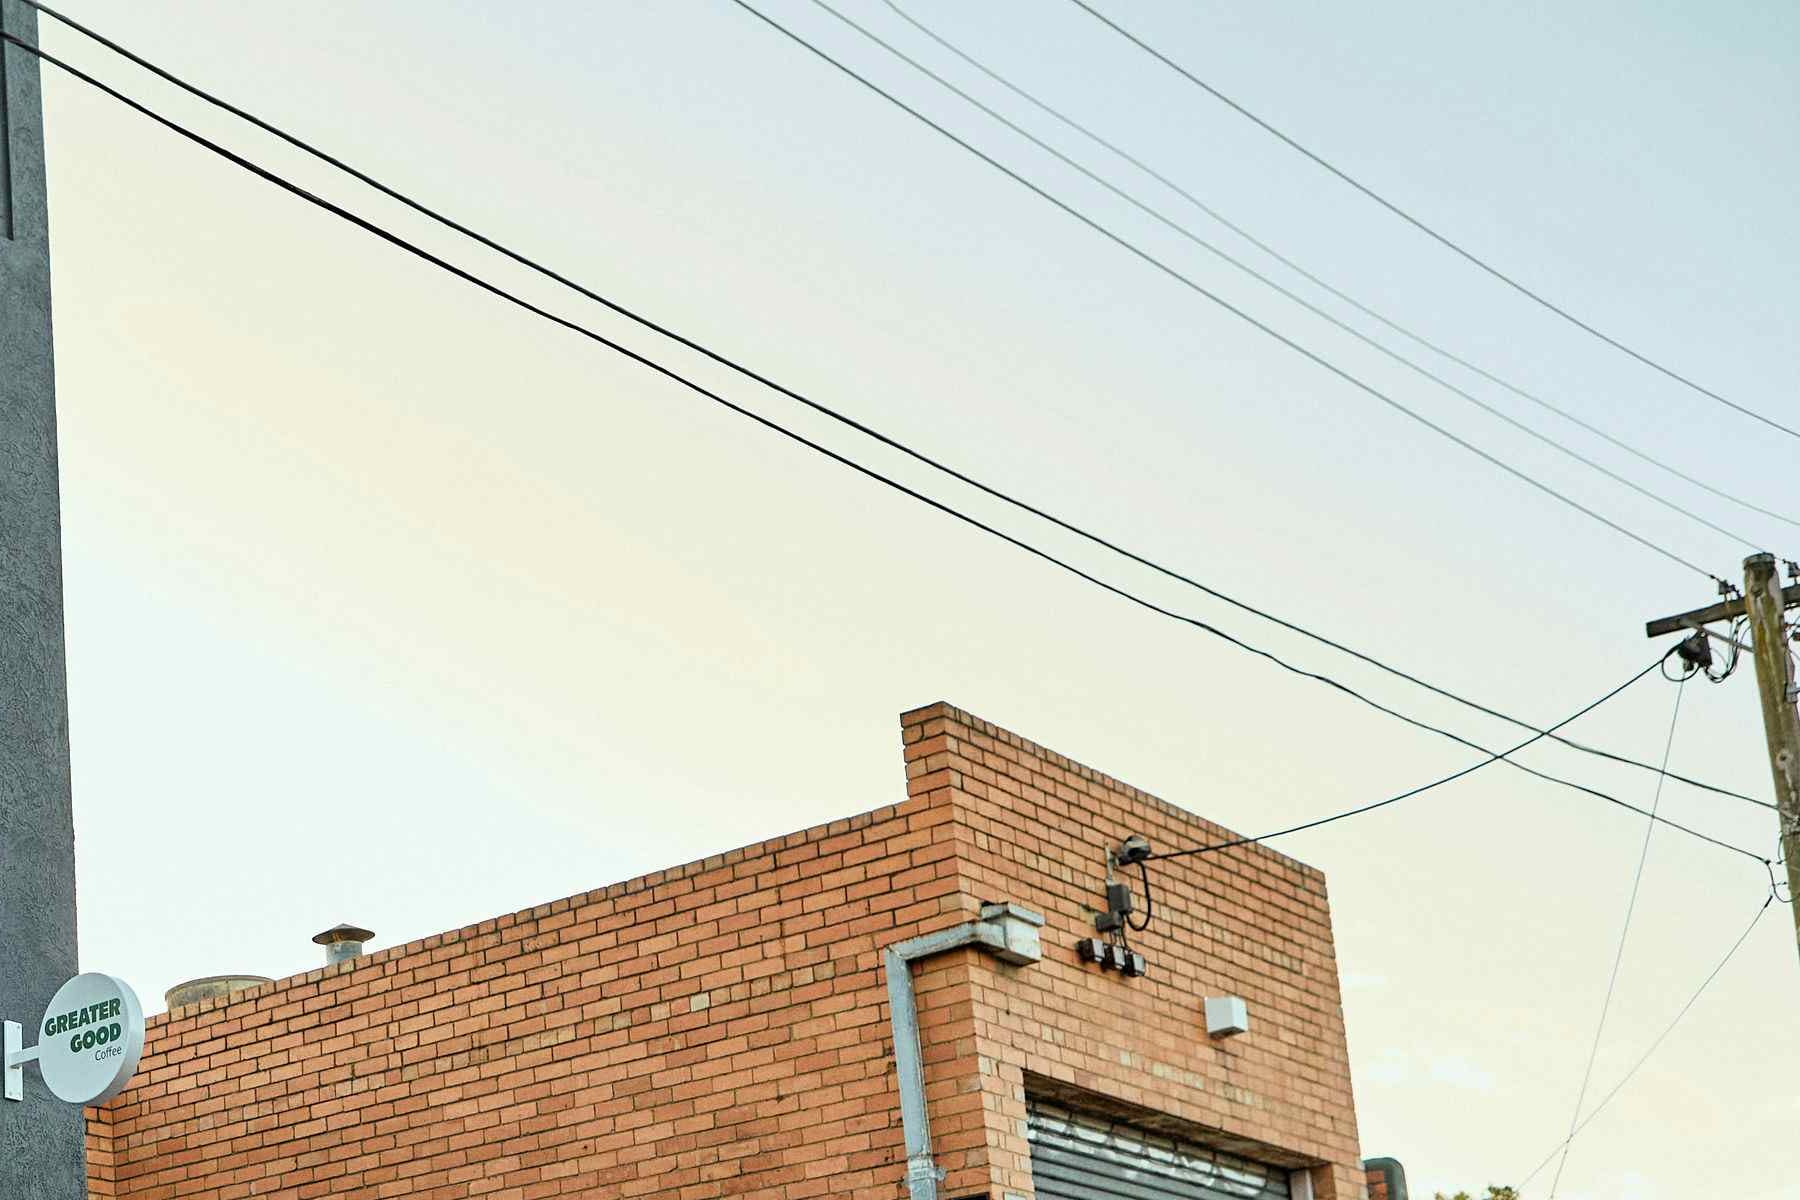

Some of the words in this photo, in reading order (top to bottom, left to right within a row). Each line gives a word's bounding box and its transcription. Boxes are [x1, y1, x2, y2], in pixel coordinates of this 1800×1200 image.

[44, 997, 121, 1036] GREATER
[70, 1022, 122, 1053] GOOD
[95, 1045, 122, 1061] Coffee
